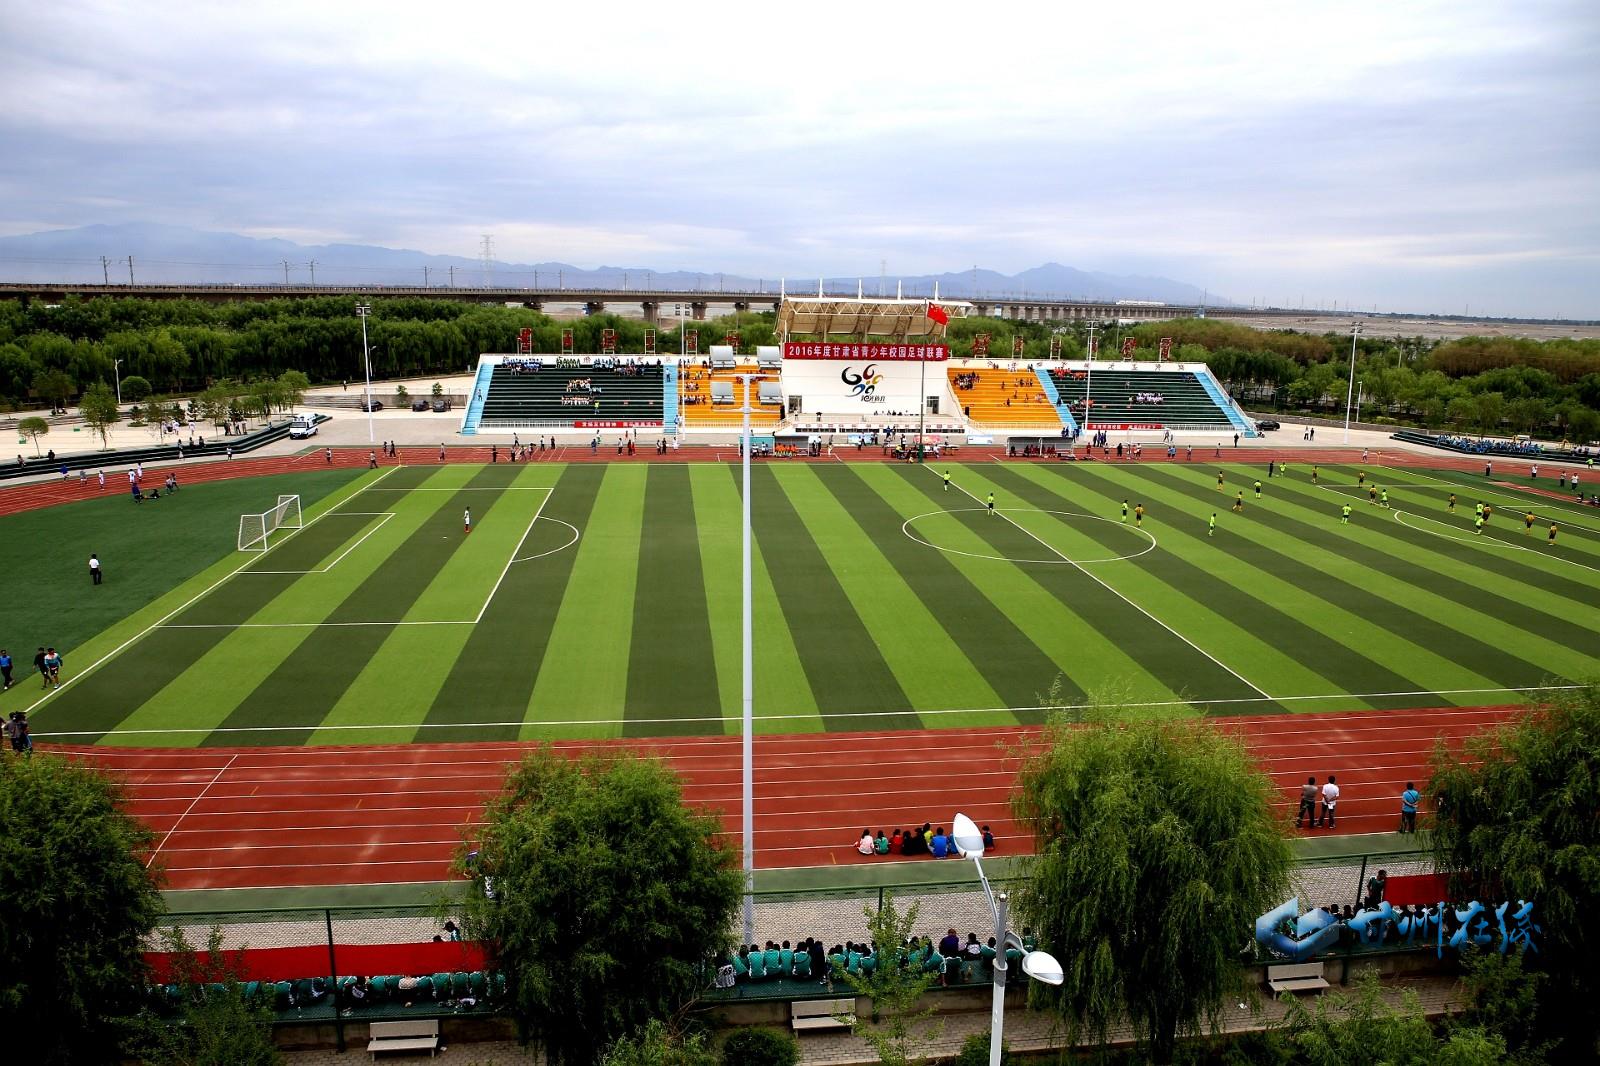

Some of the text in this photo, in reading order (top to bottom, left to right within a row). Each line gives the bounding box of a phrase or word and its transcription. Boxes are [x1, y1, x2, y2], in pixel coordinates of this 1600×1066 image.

[788, 345, 945, 359] 2016年度甘肃省青少年校园足球联赛
